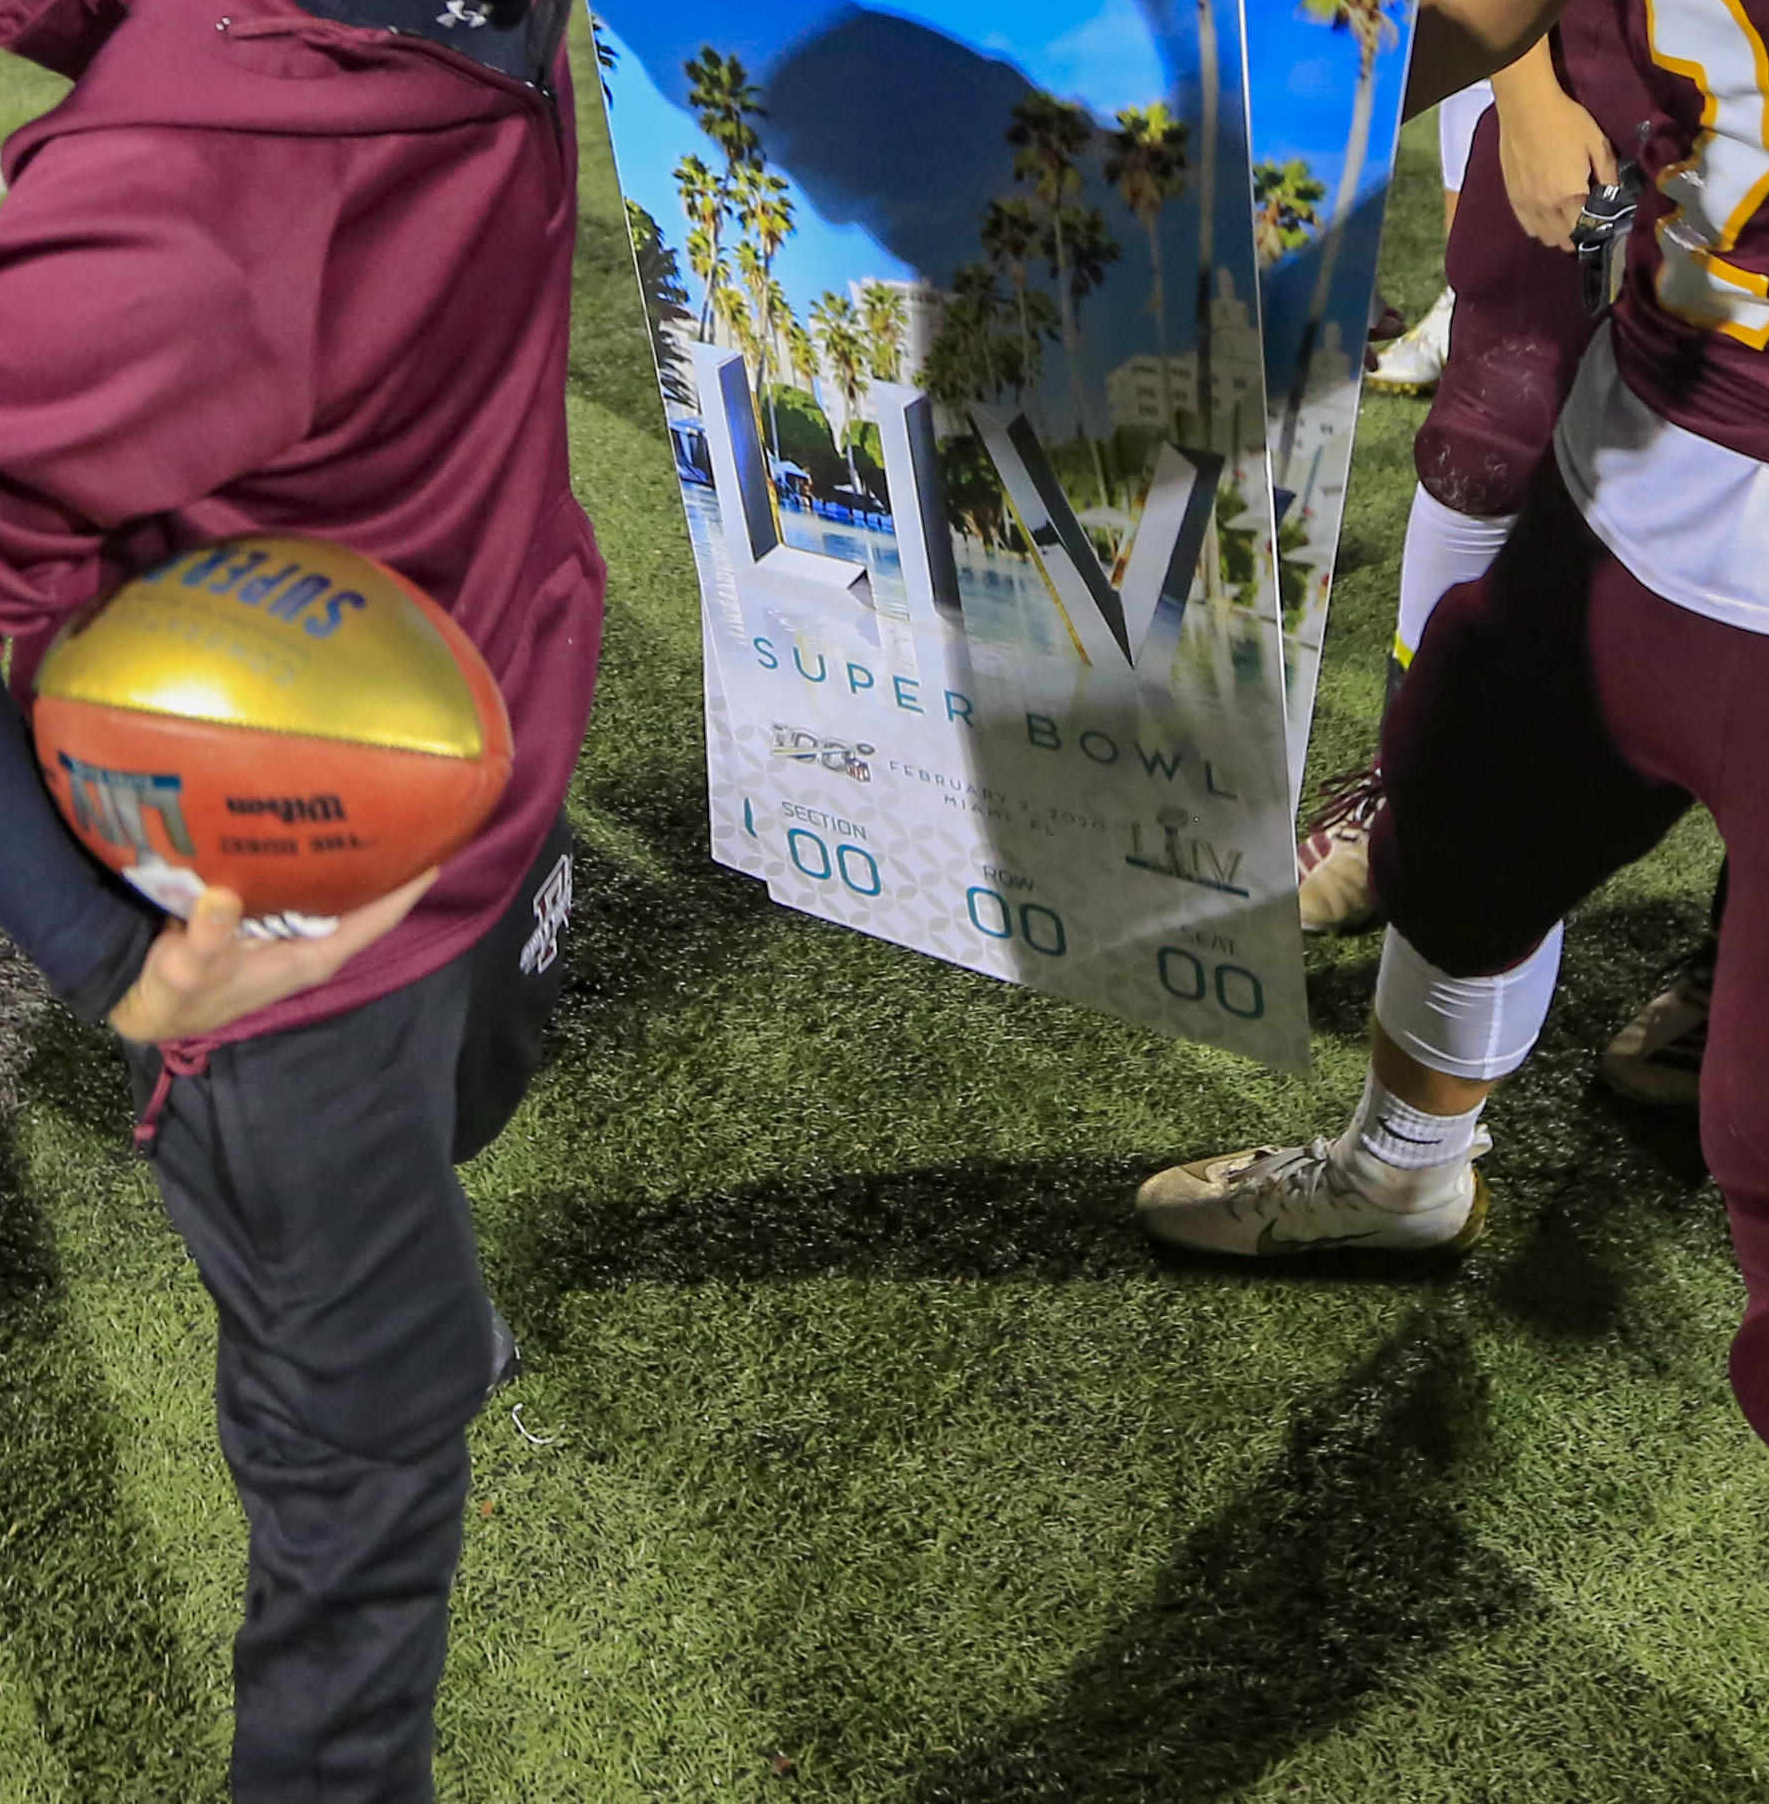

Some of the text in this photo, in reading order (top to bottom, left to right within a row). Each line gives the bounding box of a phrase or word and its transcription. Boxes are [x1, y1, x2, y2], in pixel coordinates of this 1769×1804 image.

[690, 341, 1227, 671] LIV
[752, 636, 1238, 801] SUPER BOWL
[889, 760, 1007, 804] FEBRUARY
[780, 799, 868, 841] SECTION
[786, 827, 883, 898] 00
[982, 864, 1035, 893] ROW
[966, 885, 1067, 958] 00
[1156, 945, 1265, 1021] 00
